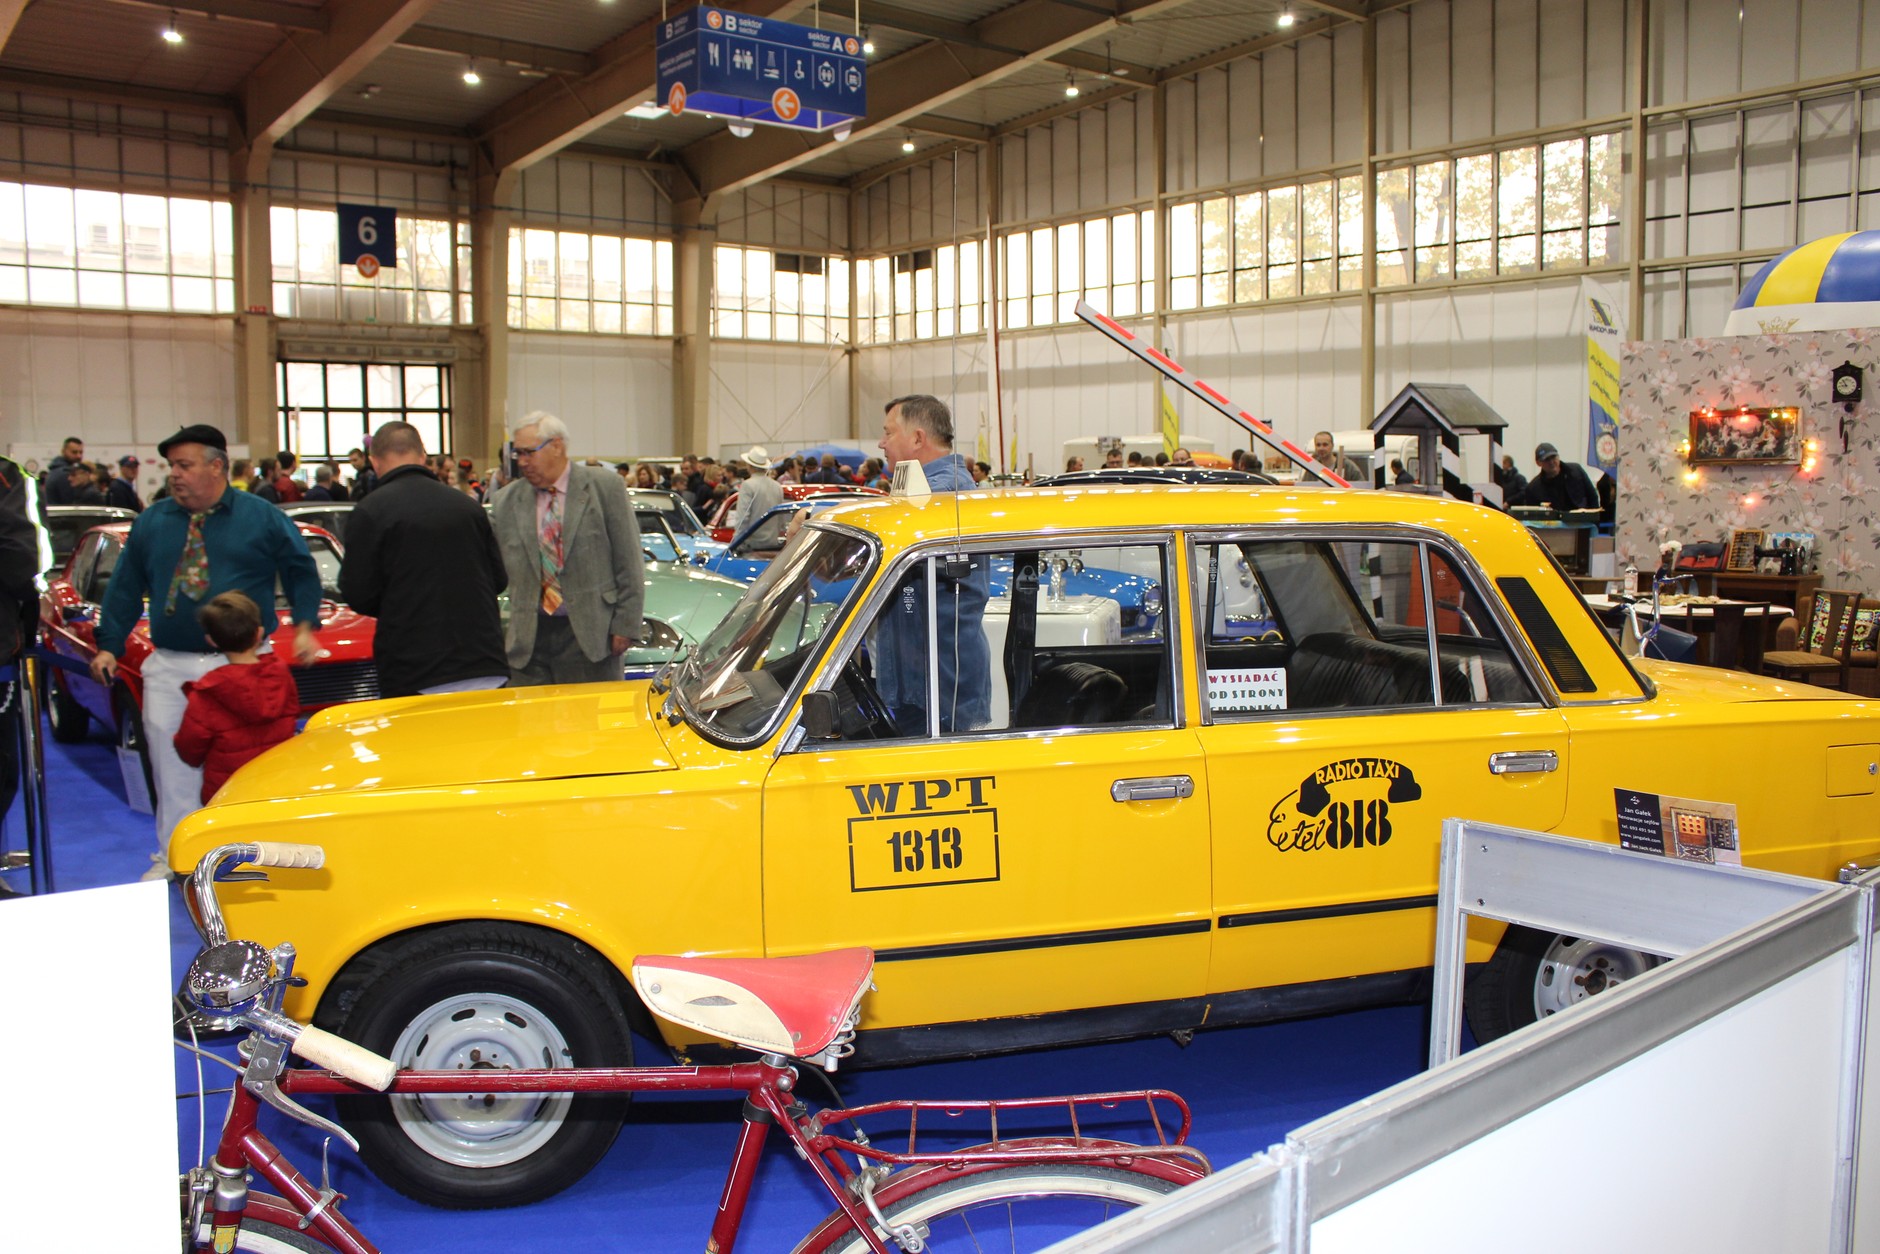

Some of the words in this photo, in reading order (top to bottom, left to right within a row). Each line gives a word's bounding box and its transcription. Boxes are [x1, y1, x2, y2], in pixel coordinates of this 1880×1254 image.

[665, 23, 674, 39] B
[725, 15, 737, 32] B
[831, 36, 844, 52] A
[358, 216, 378, 246] 6
[1208, 670, 1279, 684] WYSIADAĆ
[1208, 690, 1228, 700] OD
[1232, 688, 1284, 699] STRONY
[1315, 761, 1364, 785] RADIO
[1366, 760, 1400, 779] TAXI
[845, 776, 996, 815] WPT
[1325, 798, 1393, 850] 818
[886, 827, 963, 873] 1313
